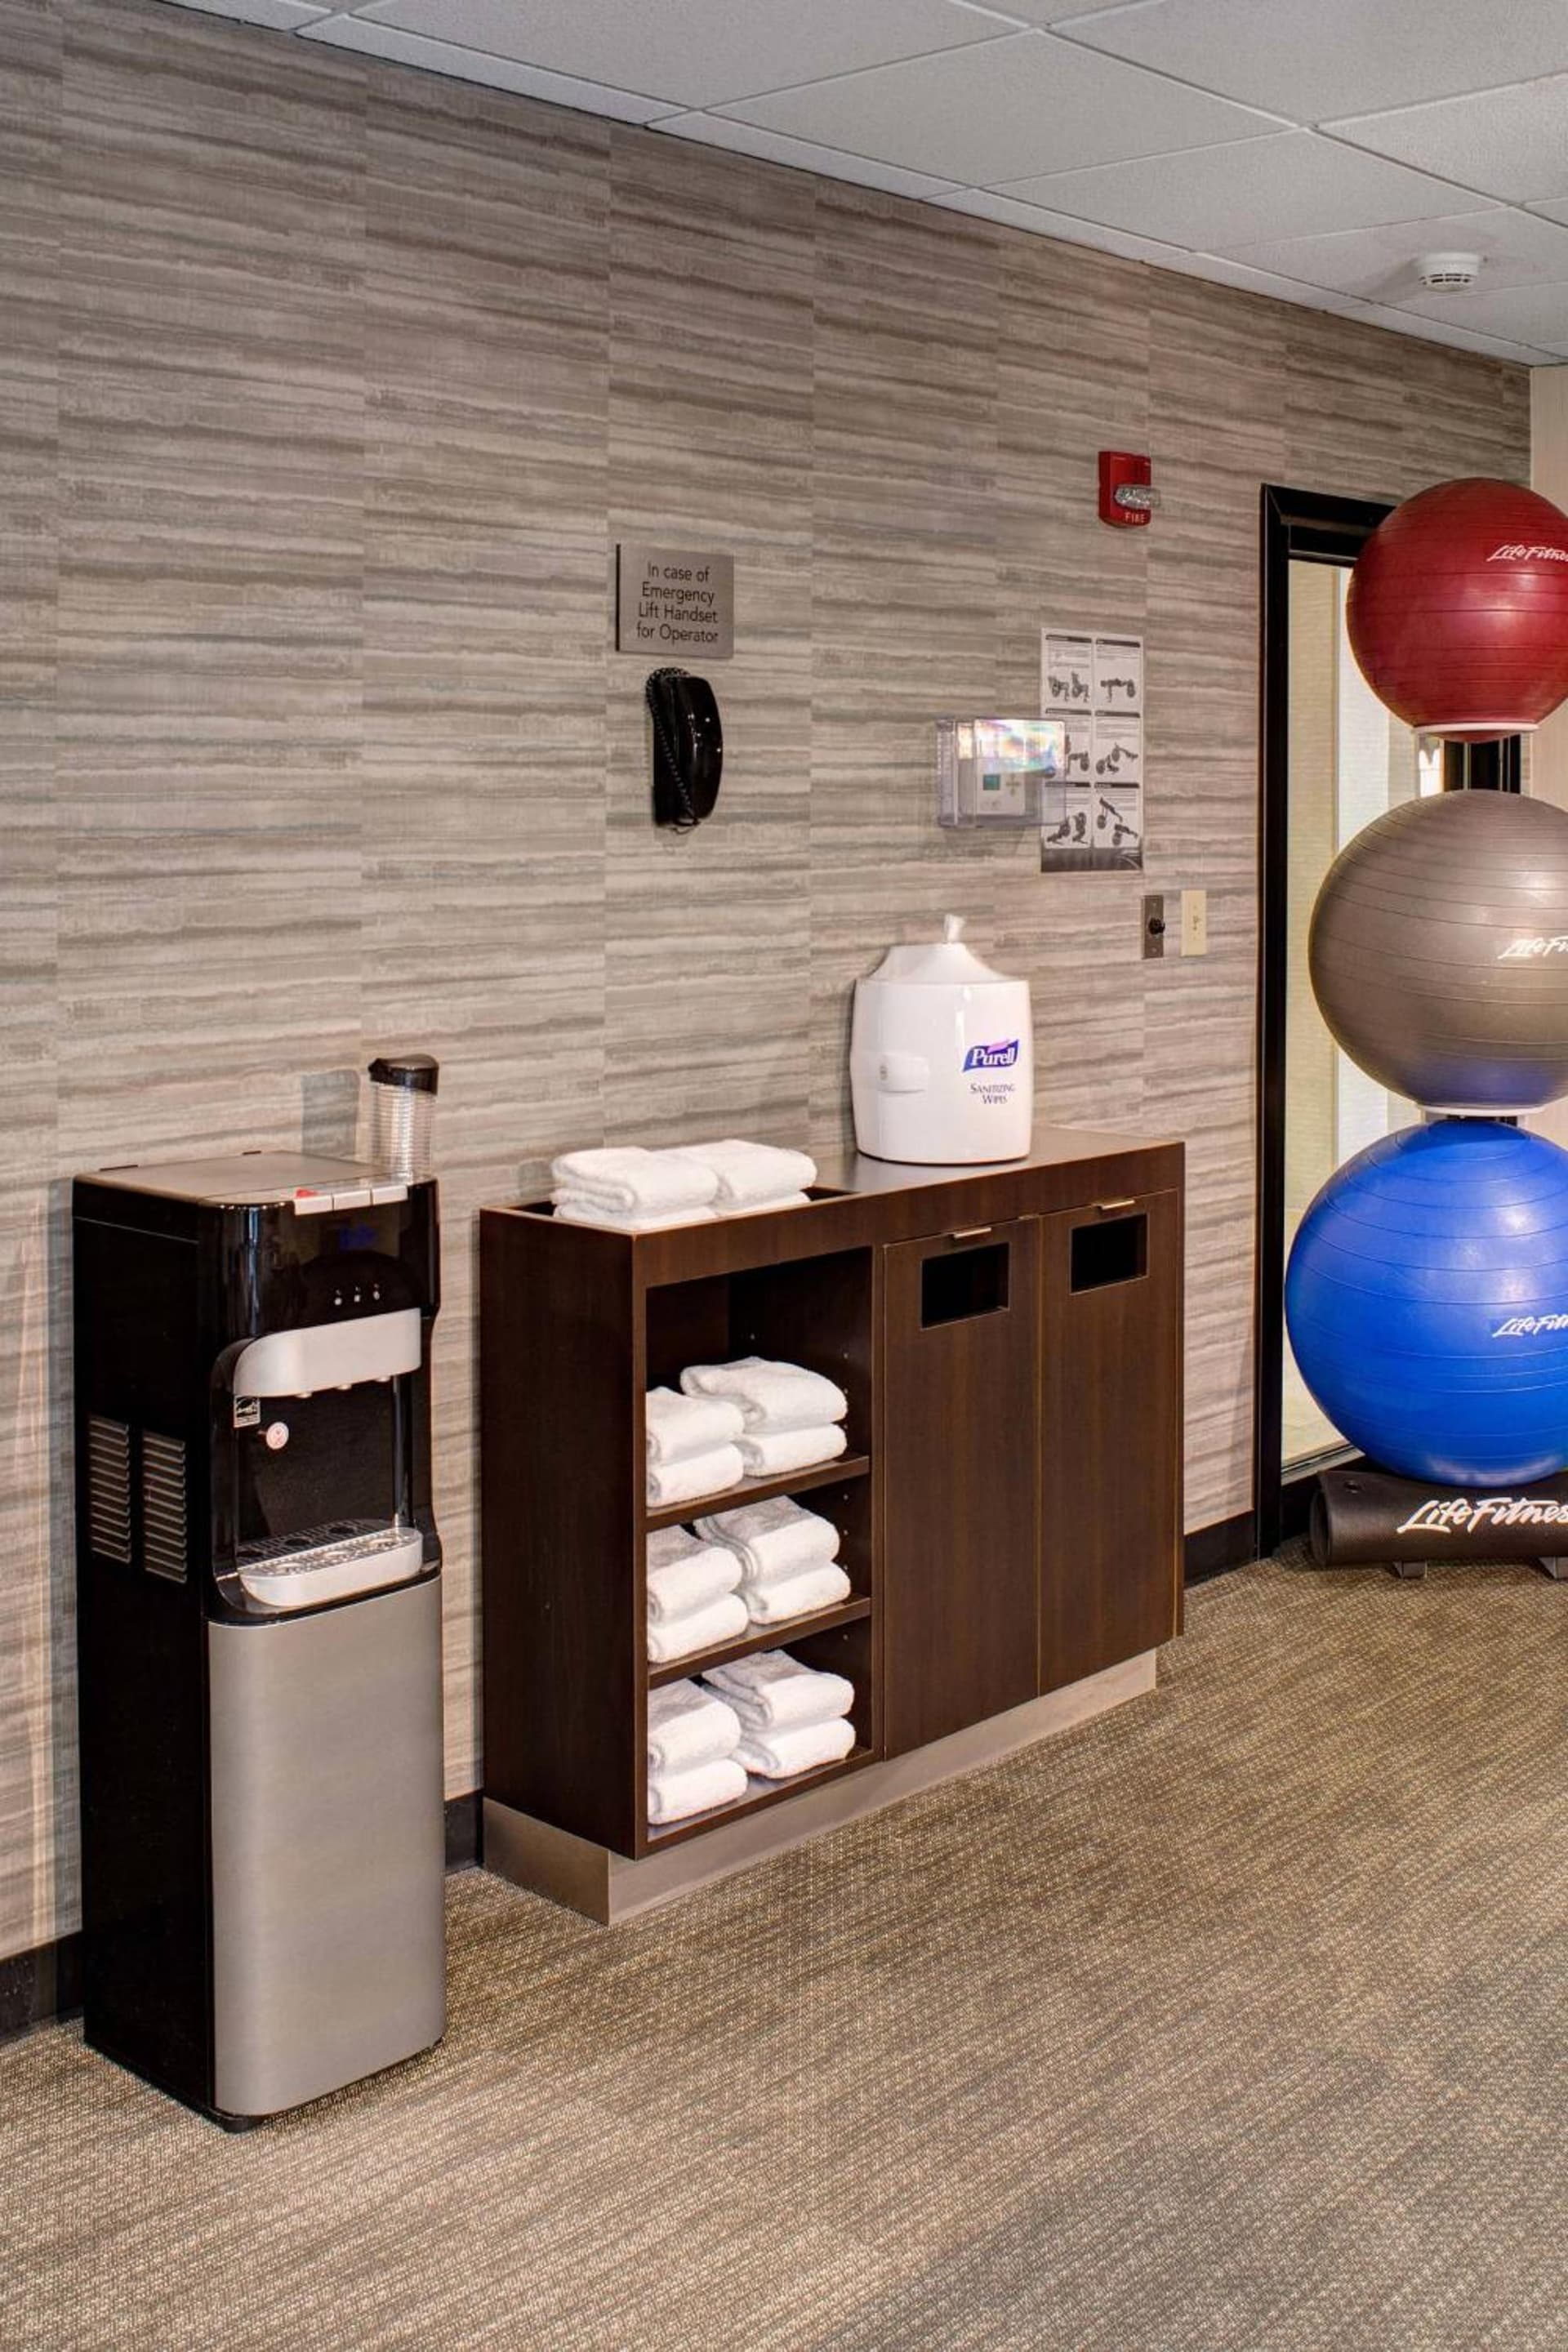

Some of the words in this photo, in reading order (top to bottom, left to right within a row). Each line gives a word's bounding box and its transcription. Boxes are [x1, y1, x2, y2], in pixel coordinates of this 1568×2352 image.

[1125, 511, 1147, 523] FIRE
[647, 562, 659, 578] In
[663, 566, 693, 581] case
[696, 566, 710, 582] of
[642, 581, 715, 608] Emergency
[639, 602, 659, 619] Lift
[664, 604, 719, 624] Handset
[636, 621, 656, 639] for
[659, 623, 719, 645] Operator
[970, 1046, 1016, 1067] Purell
